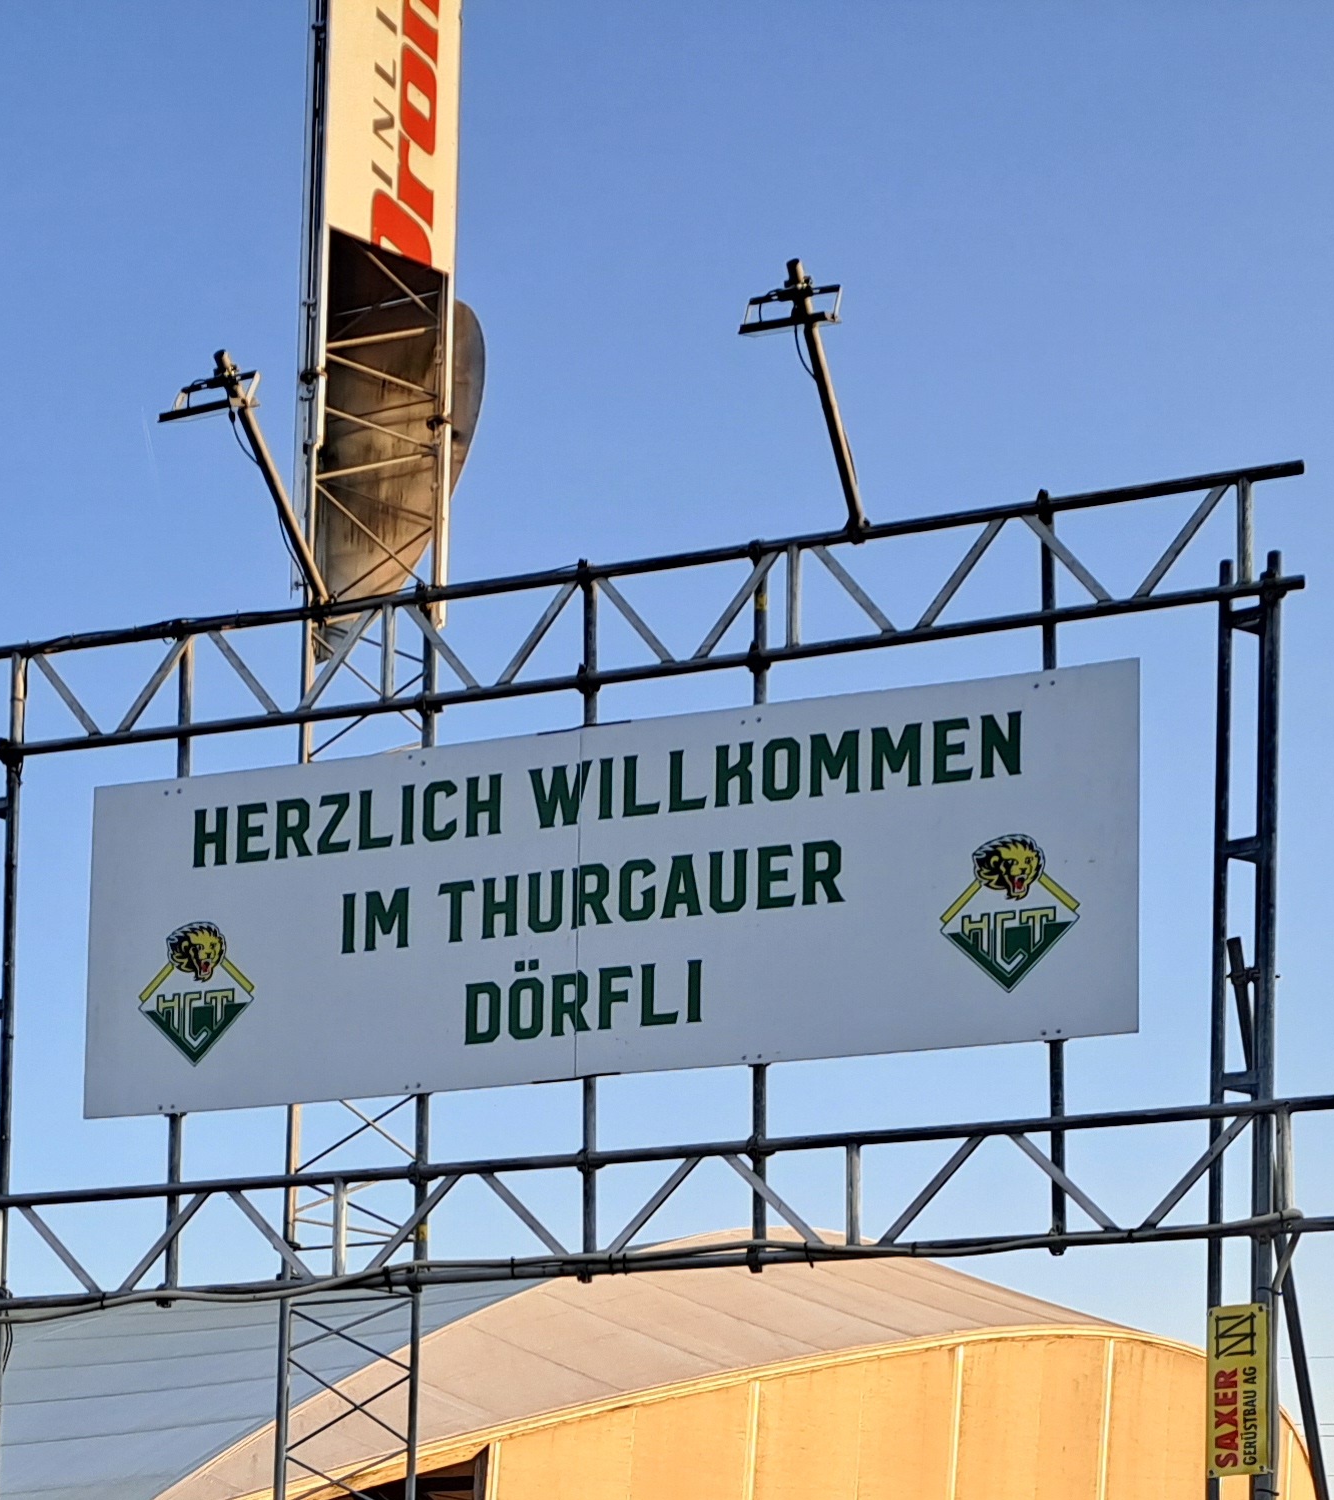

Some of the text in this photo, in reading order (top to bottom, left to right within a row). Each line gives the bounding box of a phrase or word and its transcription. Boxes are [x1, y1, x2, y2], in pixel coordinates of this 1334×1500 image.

[192, 710, 1024, 869] HERZLICH WILLKOMMEN
[340, 839, 847, 955] IM THURGAUER
[961, 906, 1057, 978] HCT
[156, 987, 236, 1052] HCT
[463, 958, 703, 1046] DÖRFLI
[1214, 1367, 1239, 1469] SAXER
[1241, 1366, 1258, 1466] GERÜSTBAU AG
